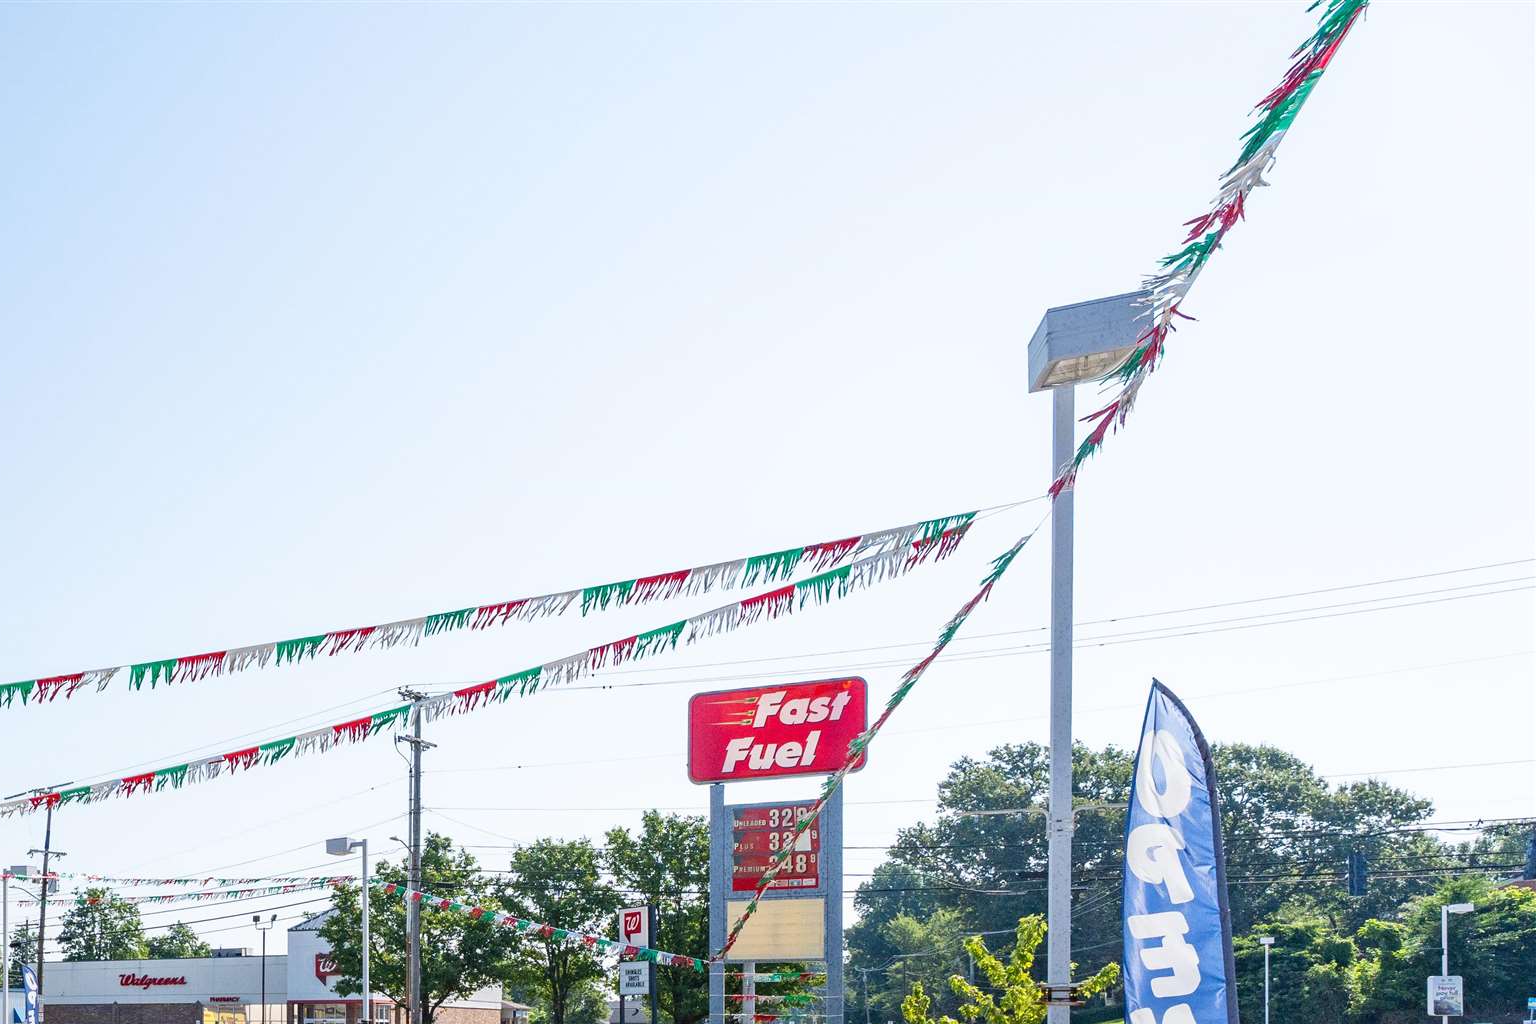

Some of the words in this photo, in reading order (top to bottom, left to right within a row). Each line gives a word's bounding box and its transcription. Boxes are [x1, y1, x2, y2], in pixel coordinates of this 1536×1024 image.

[752, 690, 852, 728] Fast
[721, 730, 822, 773] Fuel
[734, 842, 754, 850] PLUS
[733, 865, 766, 873] PREMIUM
[119, 973, 187, 989] Walgreens
